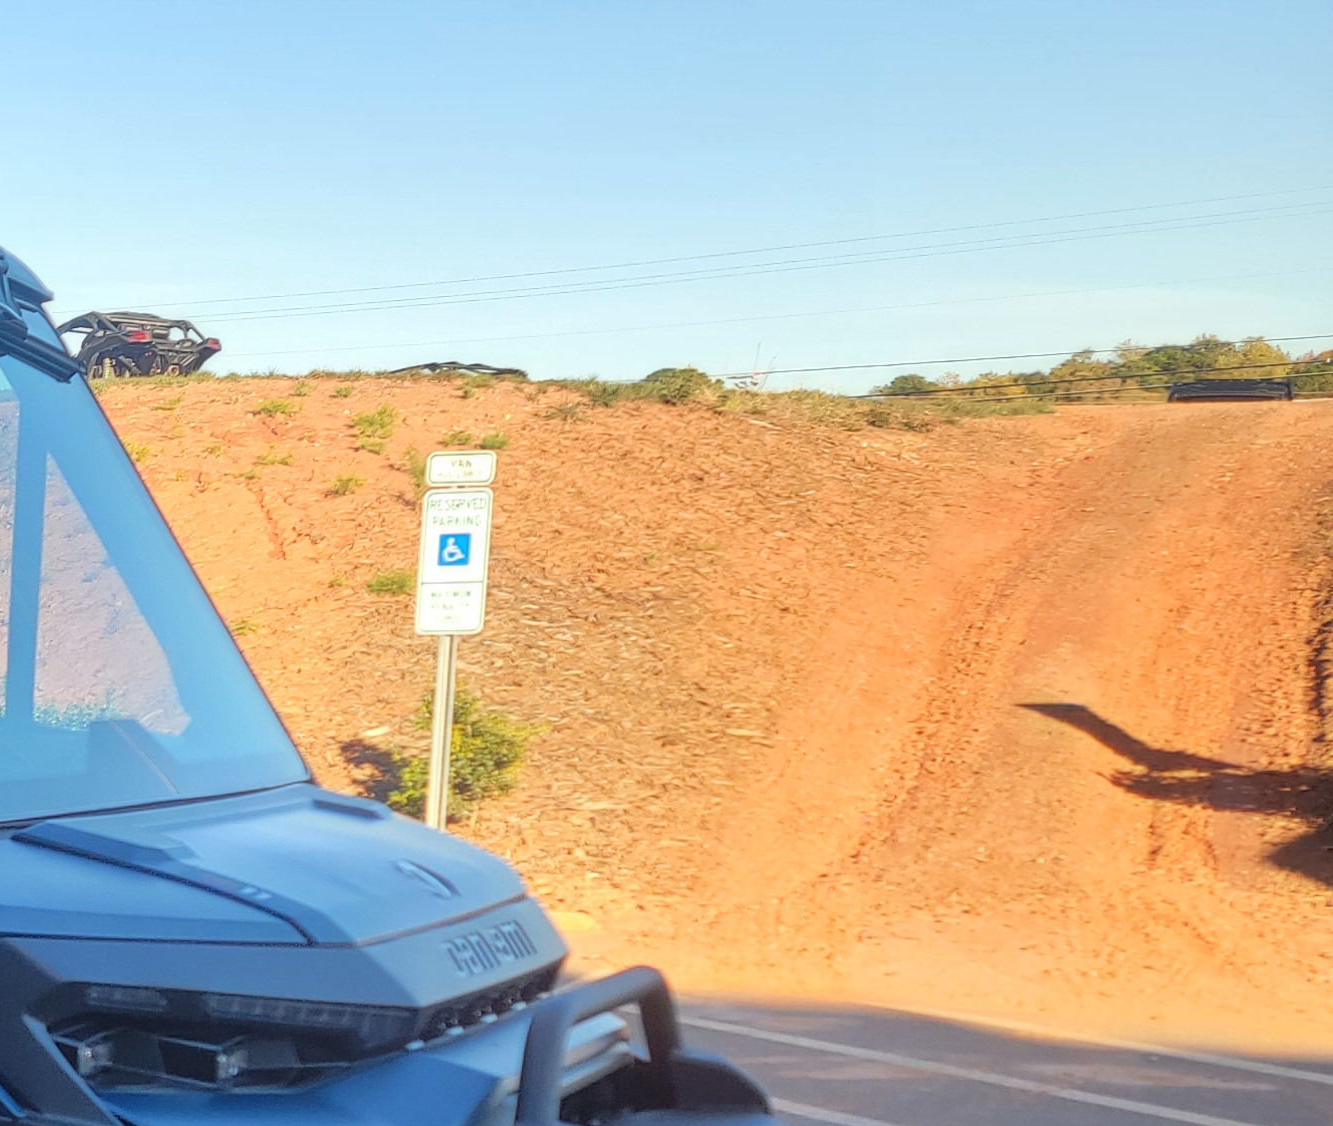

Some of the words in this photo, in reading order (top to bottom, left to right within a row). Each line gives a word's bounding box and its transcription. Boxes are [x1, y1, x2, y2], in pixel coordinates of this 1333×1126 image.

[451, 459, 472, 468] VAN
[430, 498, 487, 511] RESERVED
[432, 515, 481, 526] PARKING
